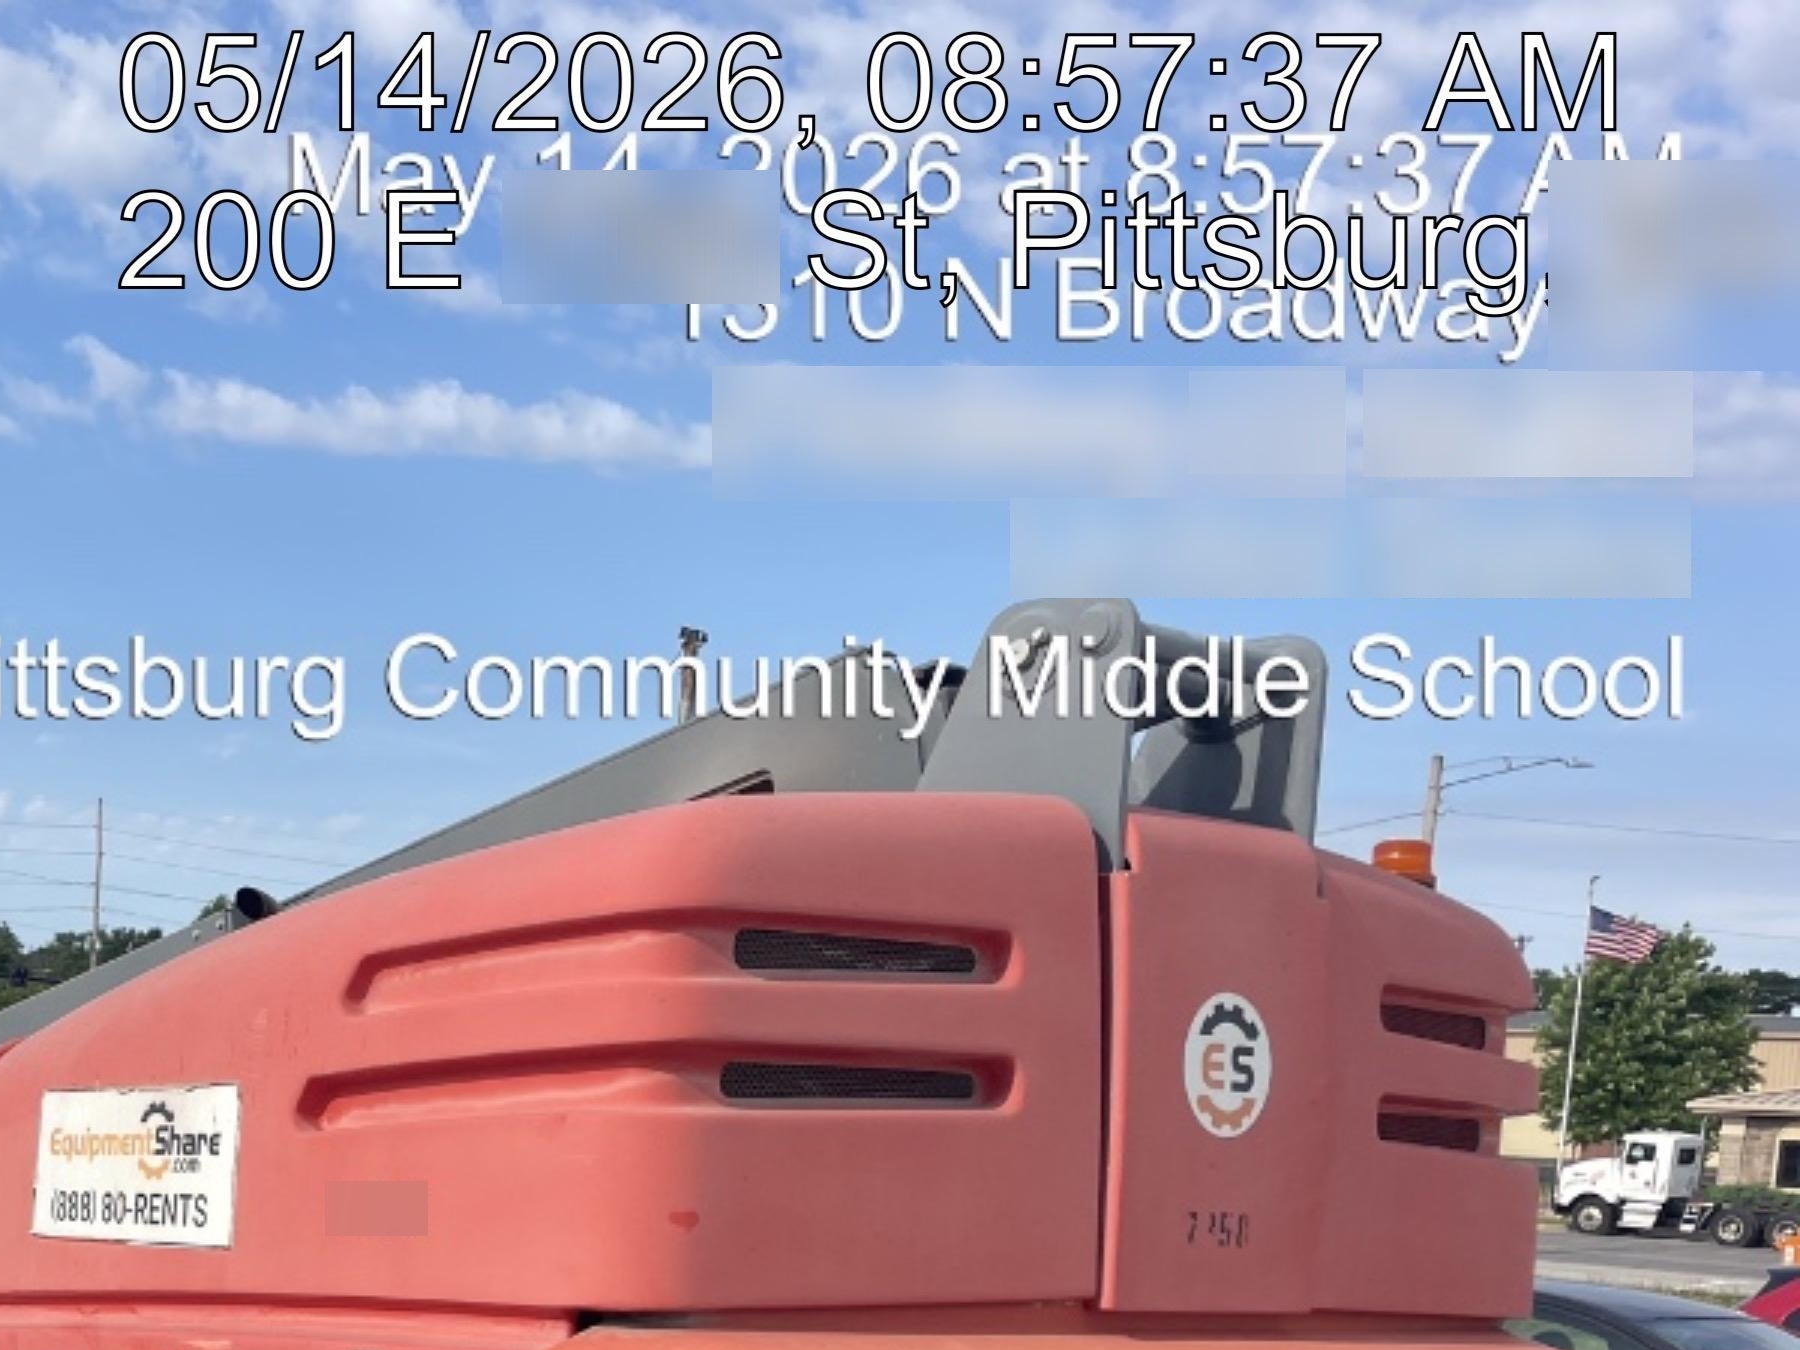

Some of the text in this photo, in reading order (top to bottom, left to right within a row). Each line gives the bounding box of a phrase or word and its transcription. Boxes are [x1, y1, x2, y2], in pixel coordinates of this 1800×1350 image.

[1202, 1043, 1255, 1093] ES
[50, 1124, 222, 1162] EquipmentShare
[51, 1189, 208, 1228] (888) 80-RENTS
